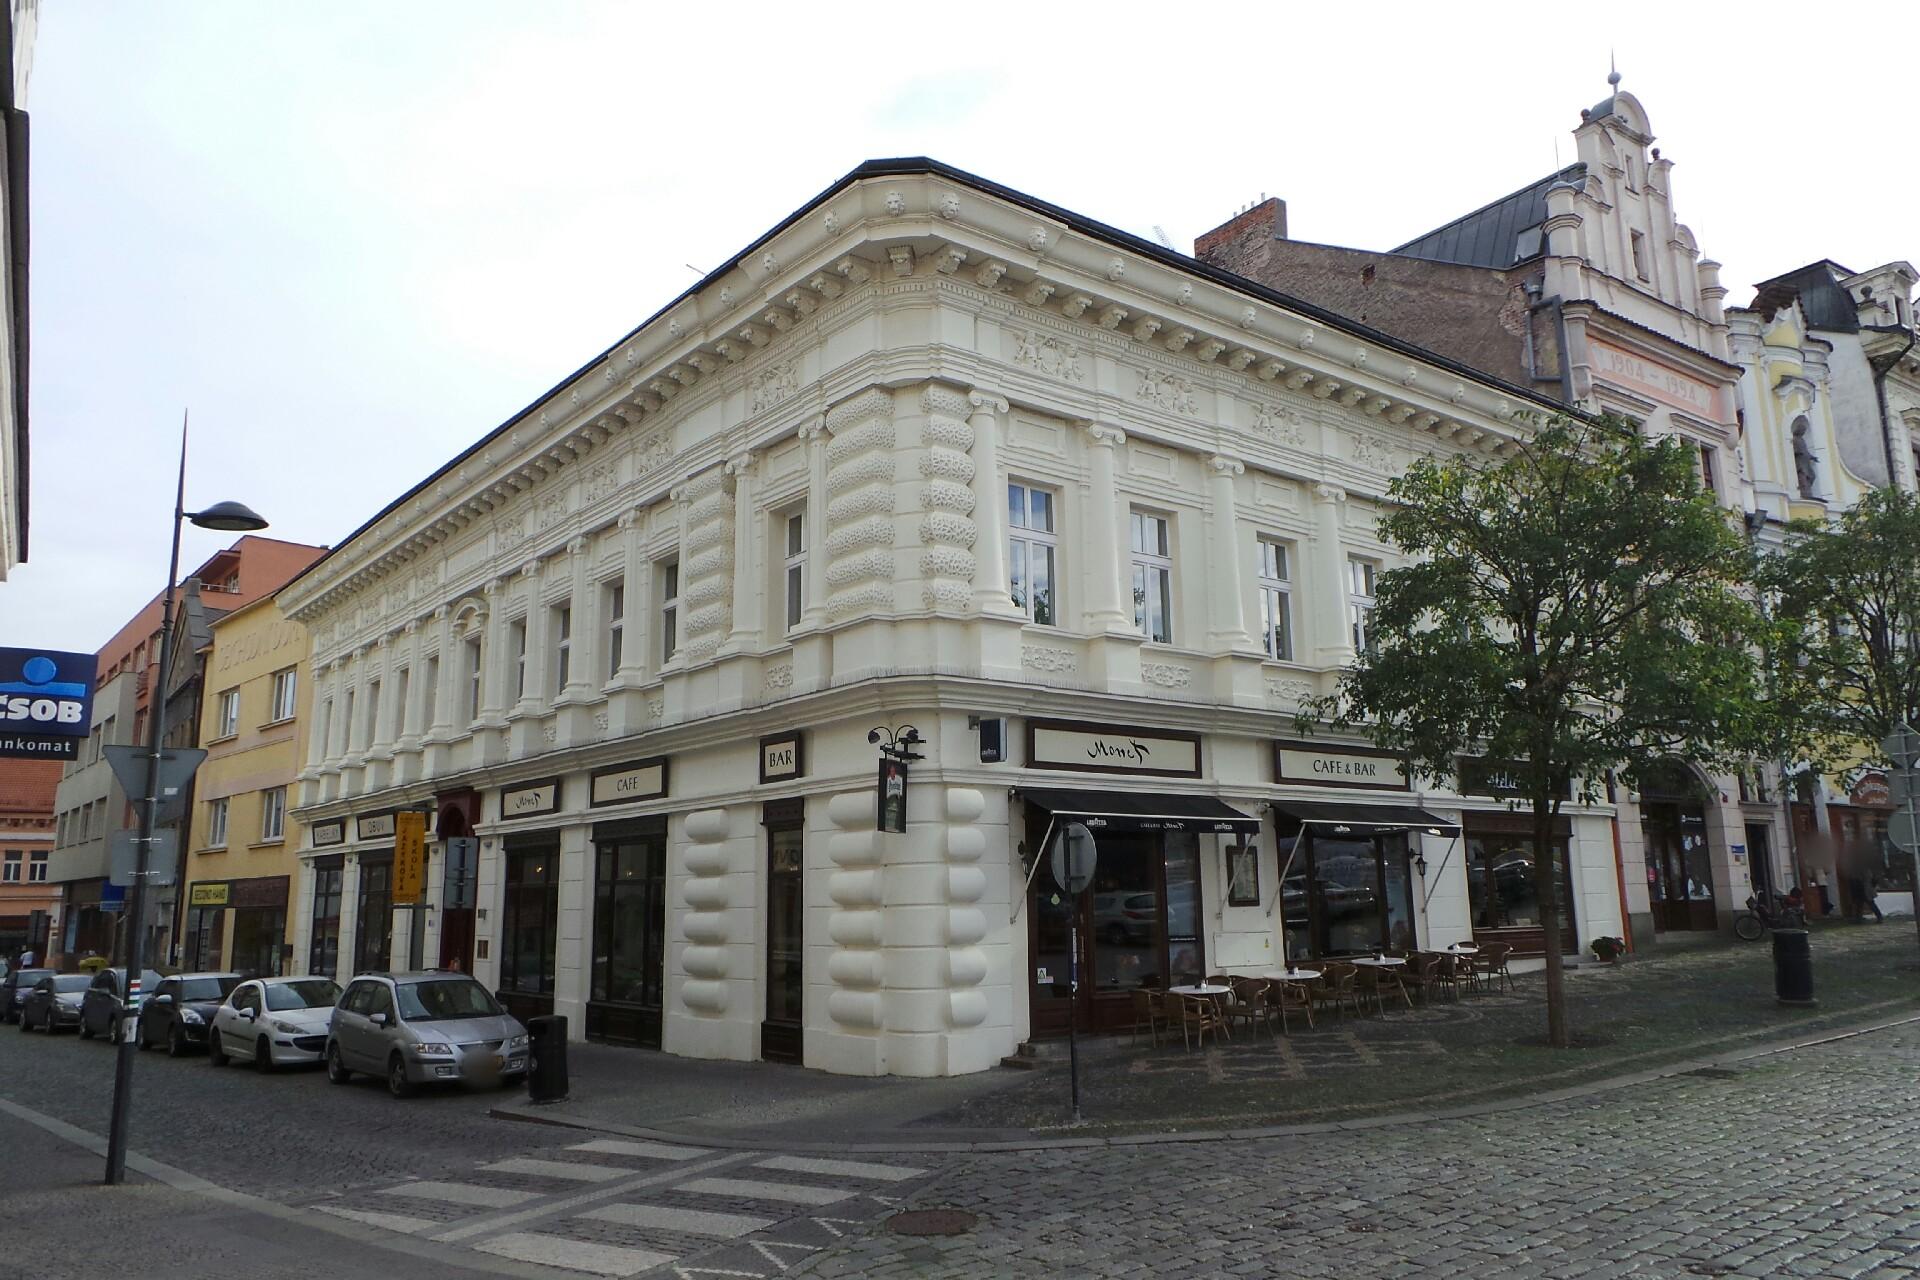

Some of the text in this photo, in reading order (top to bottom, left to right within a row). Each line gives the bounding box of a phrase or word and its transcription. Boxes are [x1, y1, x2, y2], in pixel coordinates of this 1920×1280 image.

[1611, 352, 1645, 380] 1904
[0, 737, 71, 752] nkomat
[1087, 739, 1150, 765] Monet
[769, 750, 793, 768] BAR
[1313, 759, 1376, 777] CAFE & BAR
[616, 776, 638, 792] CAFE
